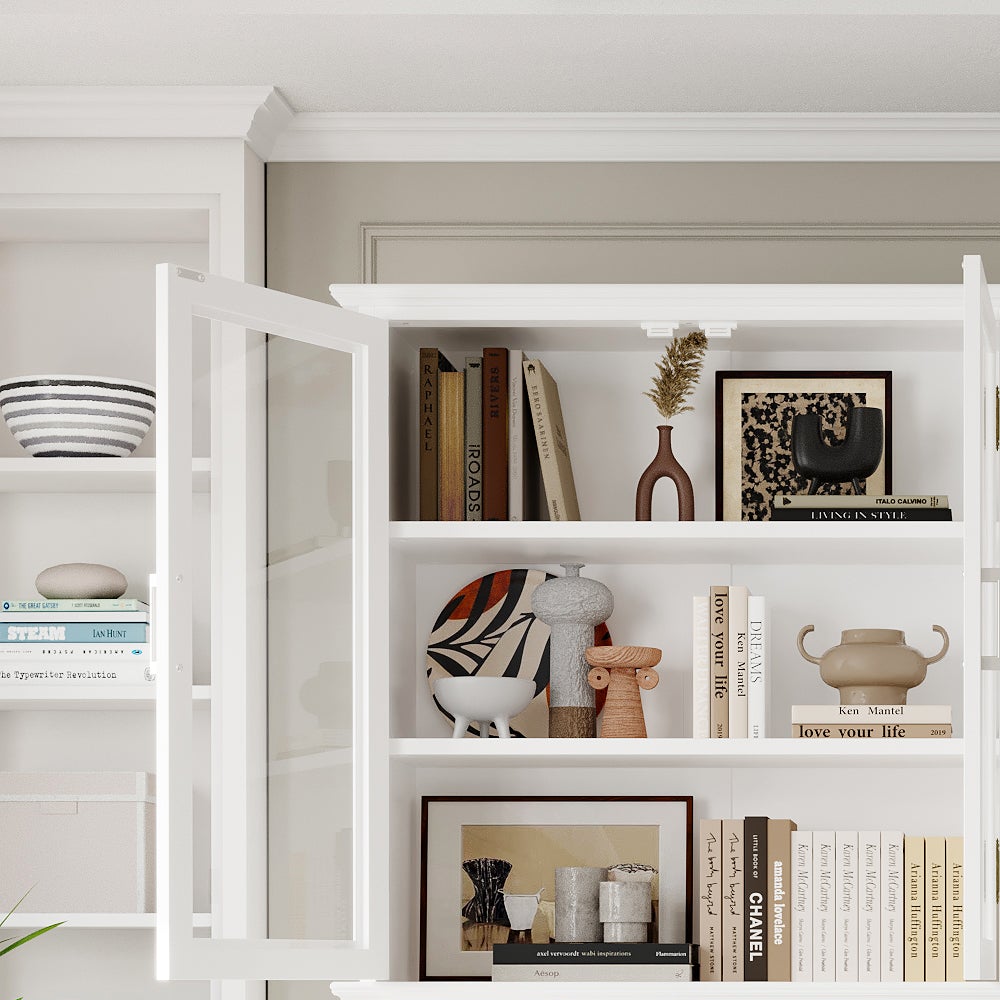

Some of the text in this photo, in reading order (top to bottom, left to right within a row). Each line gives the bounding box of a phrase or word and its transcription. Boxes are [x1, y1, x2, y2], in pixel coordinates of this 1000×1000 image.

[424, 364, 432, 450] RAPHAEL
[468, 450, 480, 512] ROADS
[812, 512, 907, 520] LIVING IN STYLE
[714, 593, 728, 624] love
[8, 626, 66, 640] STEAM
[93, 629, 126, 638] IAN HUNT
[712, 632, 724, 667] your
[750, 621, 762, 684] DREAMS
[14, 671, 64, 680] Typewriter
[67, 671, 117, 679] Revolution
[714, 676, 728, 699] life
[738, 632, 746, 697] Ken Mantel
[800, 724, 830, 738] love
[839, 728, 873, 738] your
[882, 724, 906, 738] life
[839, 706, 904, 714] Ken Mantel
[774, 861, 786, 944] amanda lovelace
[908, 862, 921, 958] Arianna Huffington
[929, 862, 942, 958] Arianna Huffington
[950, 862, 963, 958] Arianna Huffington
[750, 892, 762, 962] CHANEL
